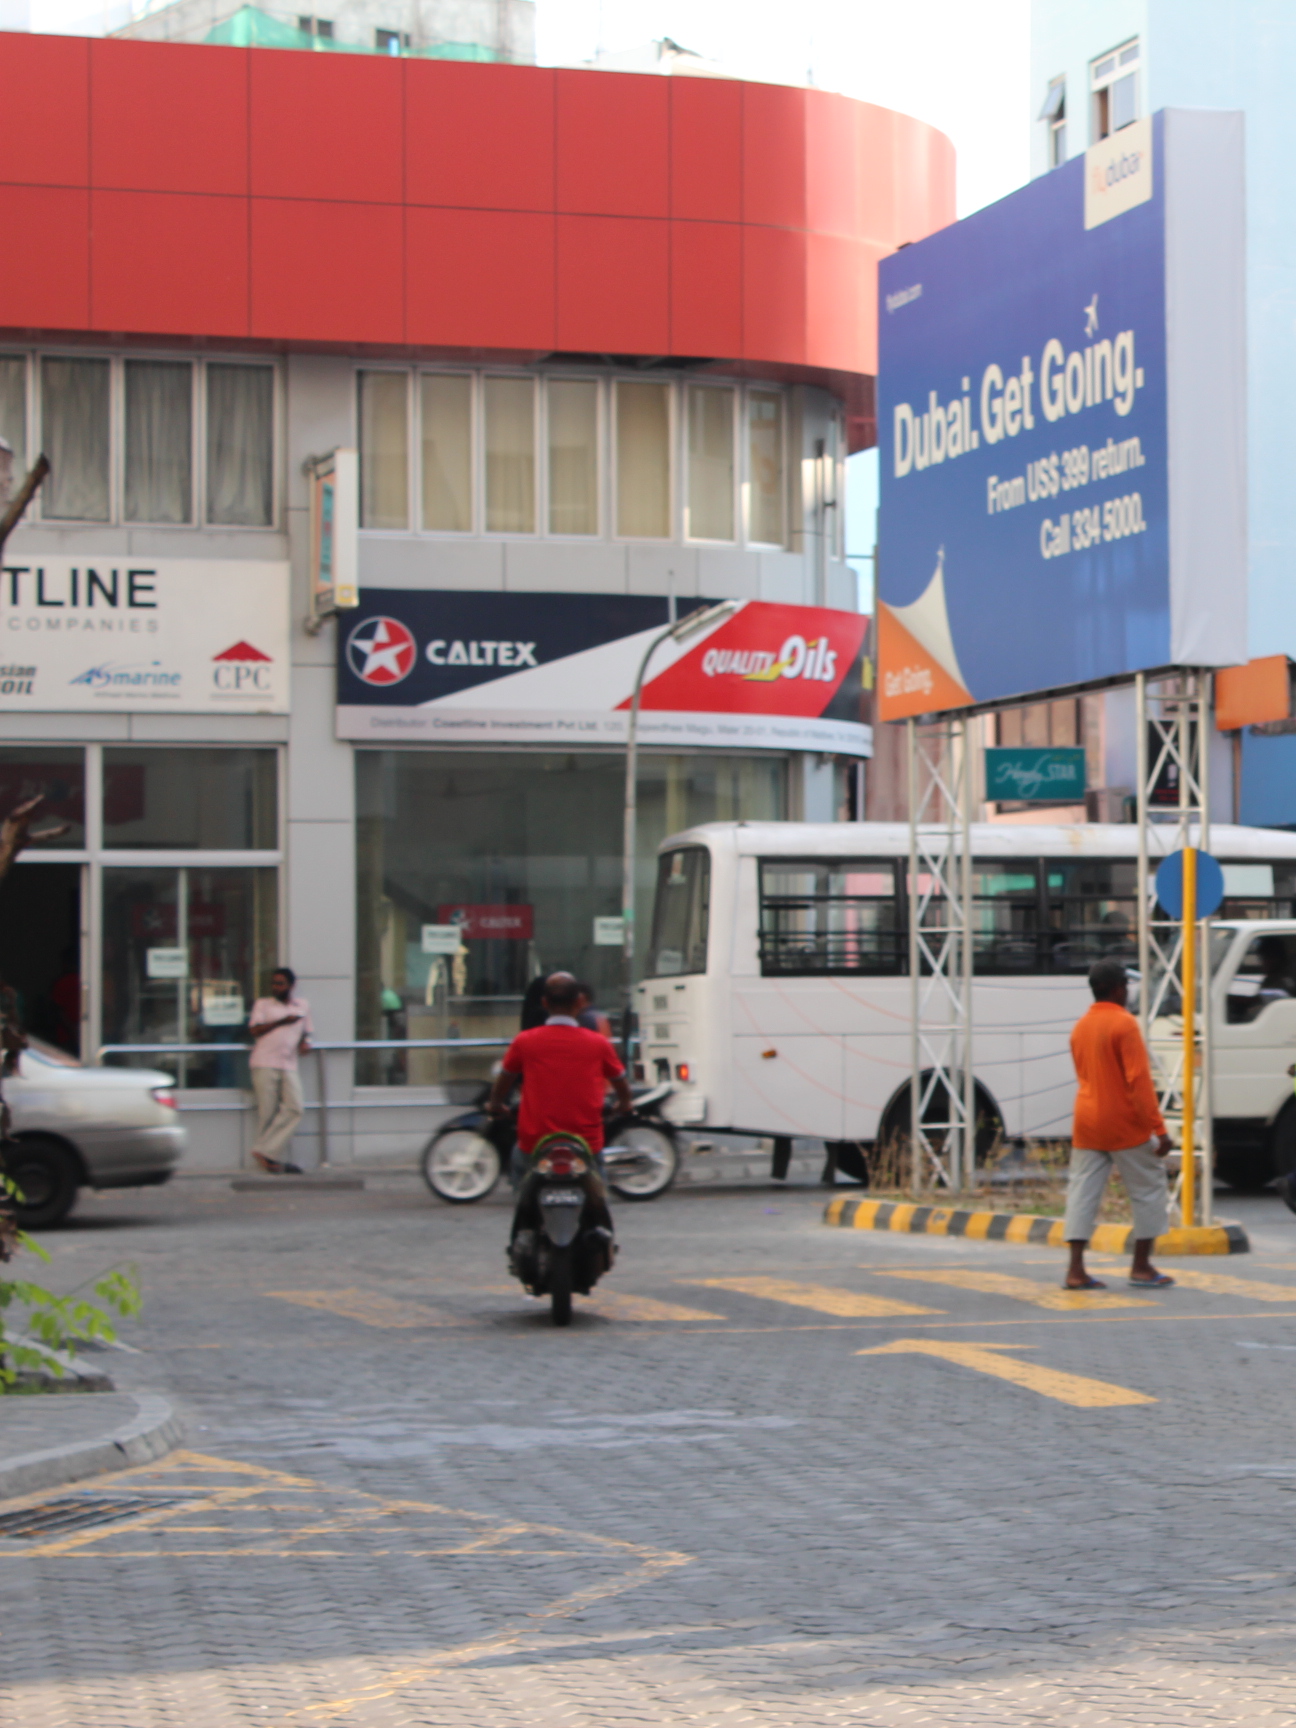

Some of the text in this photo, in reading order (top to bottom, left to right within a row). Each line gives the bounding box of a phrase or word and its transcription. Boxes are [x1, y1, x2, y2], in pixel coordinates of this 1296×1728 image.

[893, 329, 1145, 478] Dubai. Get Going.
[987, 436, 1146, 515] From US$ 399 return.
[1040, 492, 1147, 560] Call 334 5000.
[8, 617, 159, 633] COMPANIES
[425, 639, 539, 668] CALTEX
[702, 634, 838, 682] QUALITY Oils
[213, 665, 271, 690] CPC
[432, 717, 487, 729] Coastline
[491, 718, 553, 730] Investment
